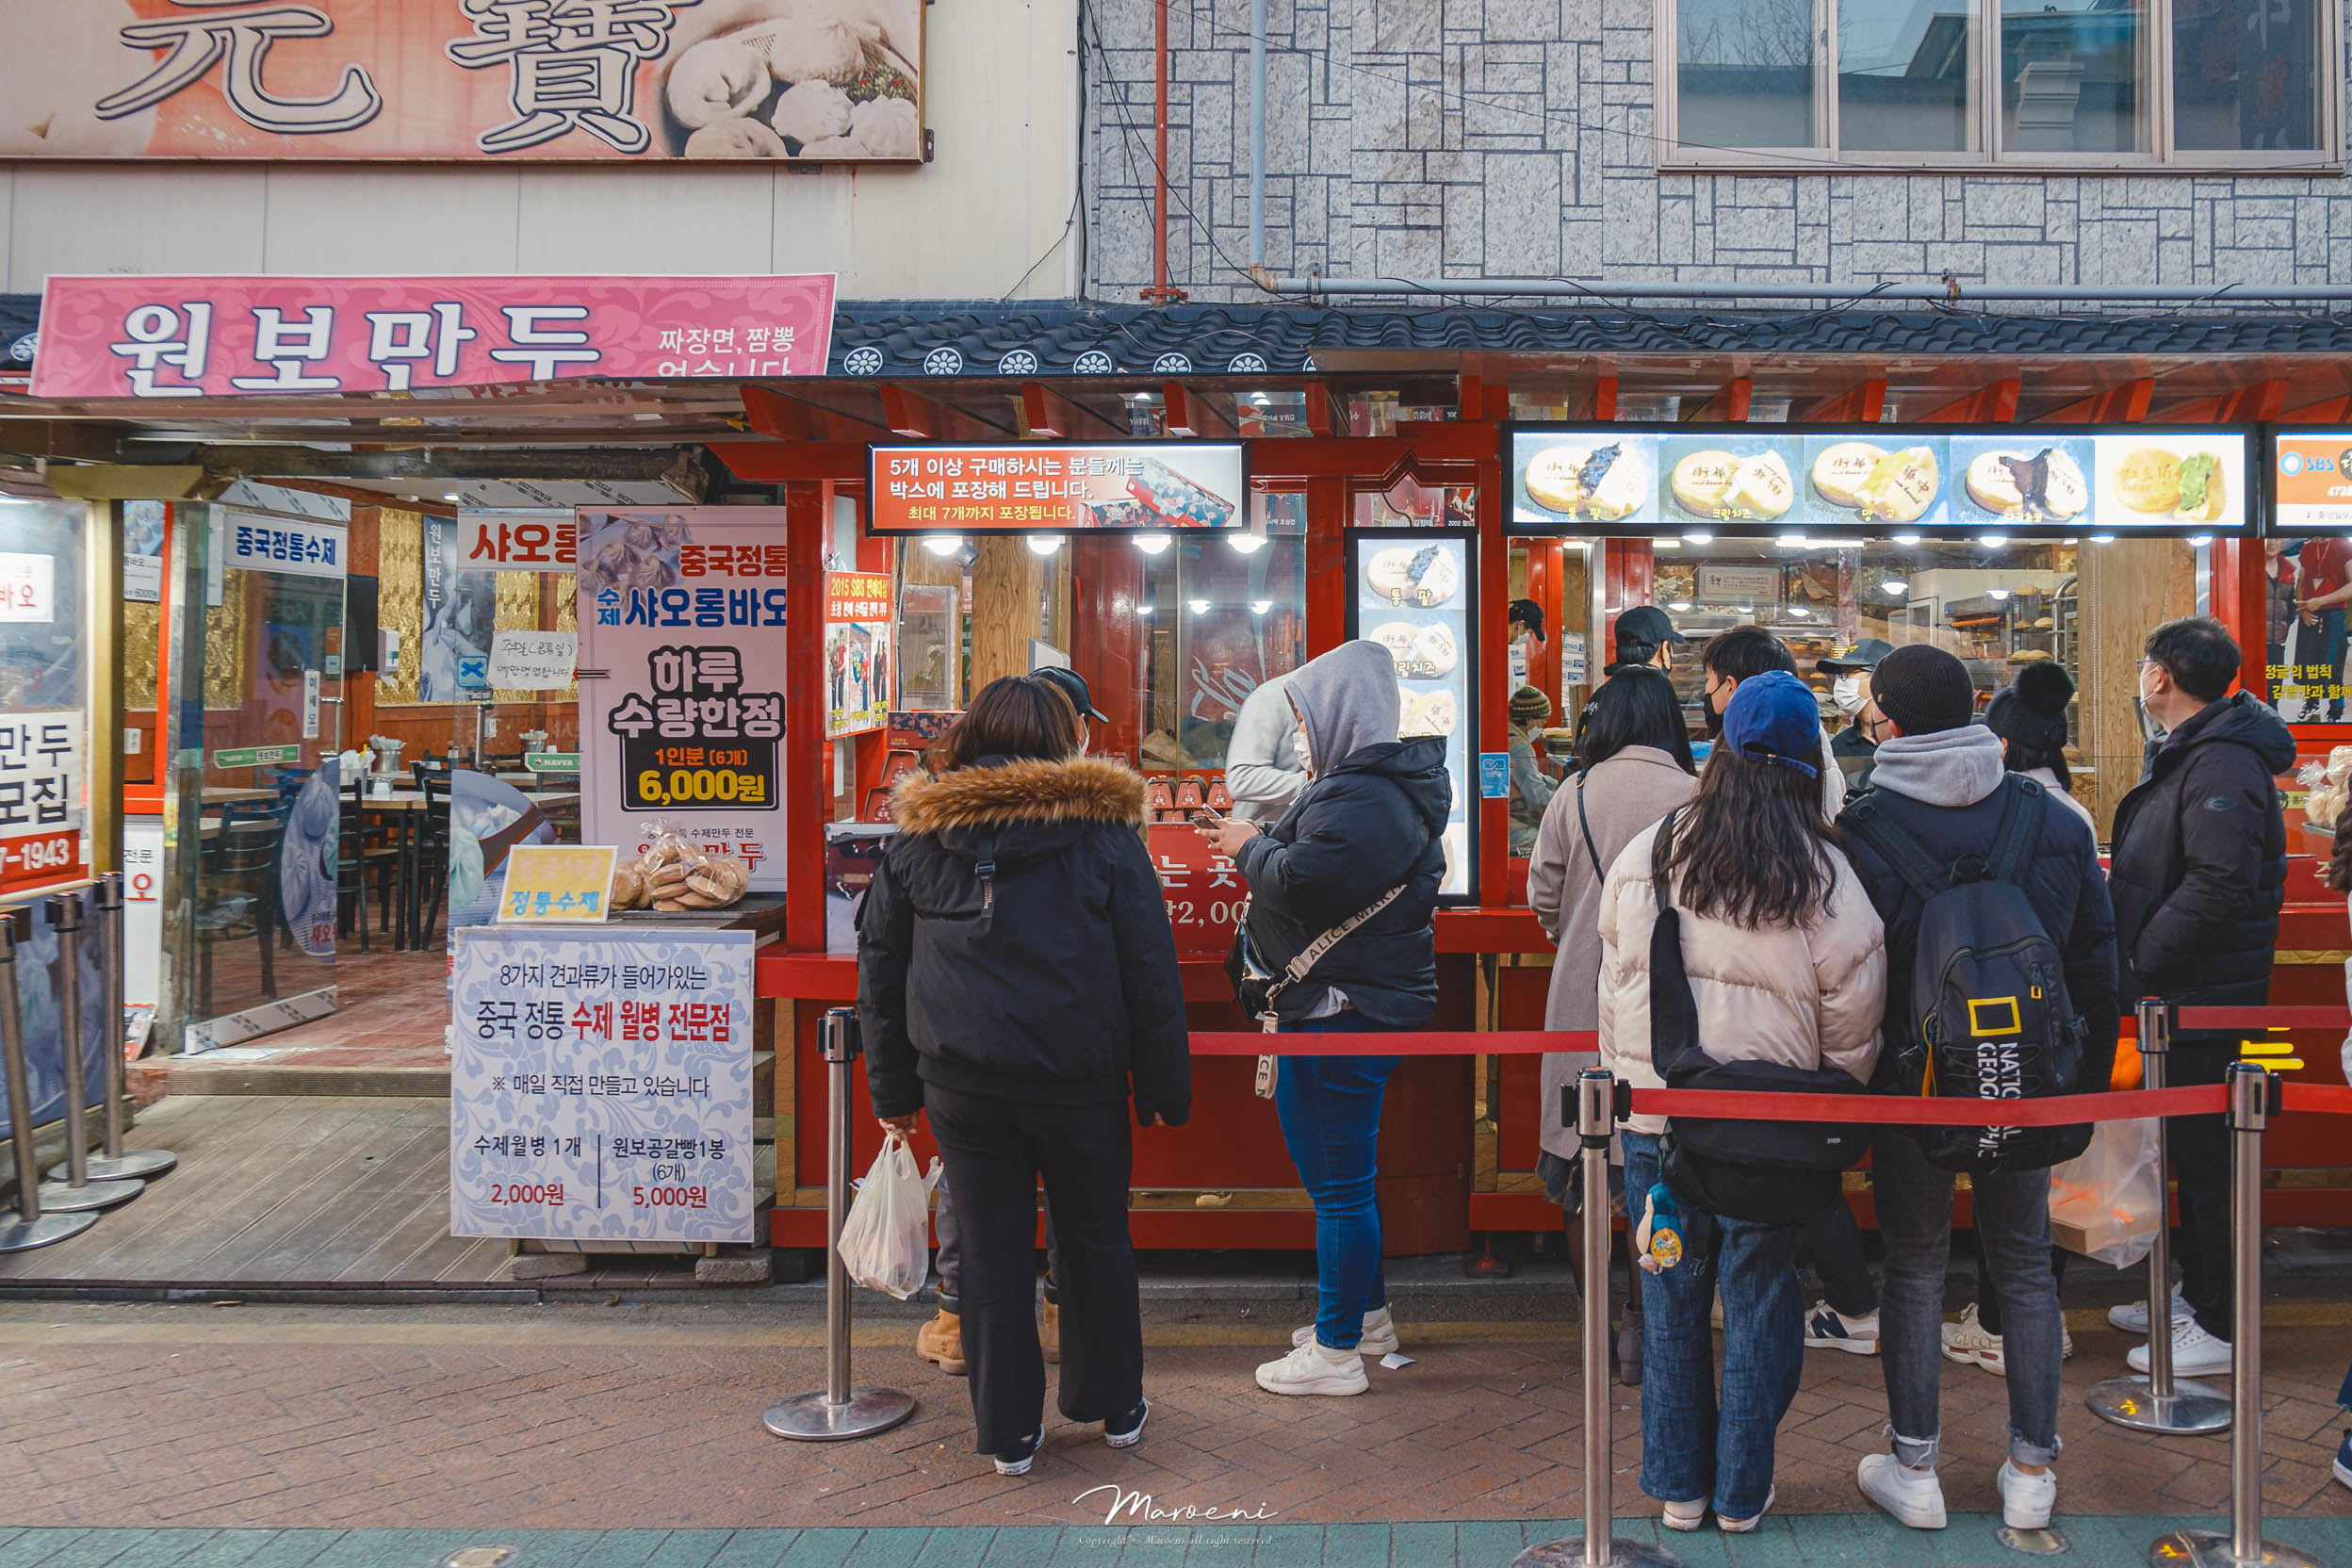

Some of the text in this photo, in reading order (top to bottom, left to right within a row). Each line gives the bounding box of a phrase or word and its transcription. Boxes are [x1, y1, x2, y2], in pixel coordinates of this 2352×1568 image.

[109, 301, 602, 398] 원보만두
[890, 457, 1144, 478] 5개 이상 구매하시는 분들께는
[2306, 458, 2335, 471] SBS
[890, 479, 1094, 500] 박스에 포장해 드립니다.
[907, 505, 1077, 522] 최대 7개까지 포장됩니다.
[1712, 506, 1753, 521] 크림치즈
[236, 525, 336, 566] 중국정통수제
[678, 544, 787, 577] 중국정통
[831, 577, 850, 597] 2015
[851, 578, 865, 597] SBS
[624, 587, 787, 628] 샤오롱바오
[652, 648, 739, 694] 하루
[2265, 663, 2332, 679] 정글의 법칙
[613, 696, 781, 739] 수량한정
[655, 747, 706, 767] 1인분
[0, 774, 68, 825] 모집
[638, 770, 766, 806] 6,000원
[691, 828, 732, 839] 수제만두
[735, 828, 755, 839] 전문
[510, 890, 600, 916] 정통수제
[1309, 921, 1352, 961] ALICE
[499, 963, 708, 990] 8가지 견과류가 들어가있는
[476, 1000, 730, 1042] 중국 정통 수제 월병 전문점
[513, 1073, 710, 1098] 매일 직접 만들고 있습니다
[473, 1135, 547, 1158] 수제월병
[651, 1162, 687, 1183] (6개)
[490, 1183, 564, 1207] 2,000원
[632, 1184, 709, 1210] 5,000원
